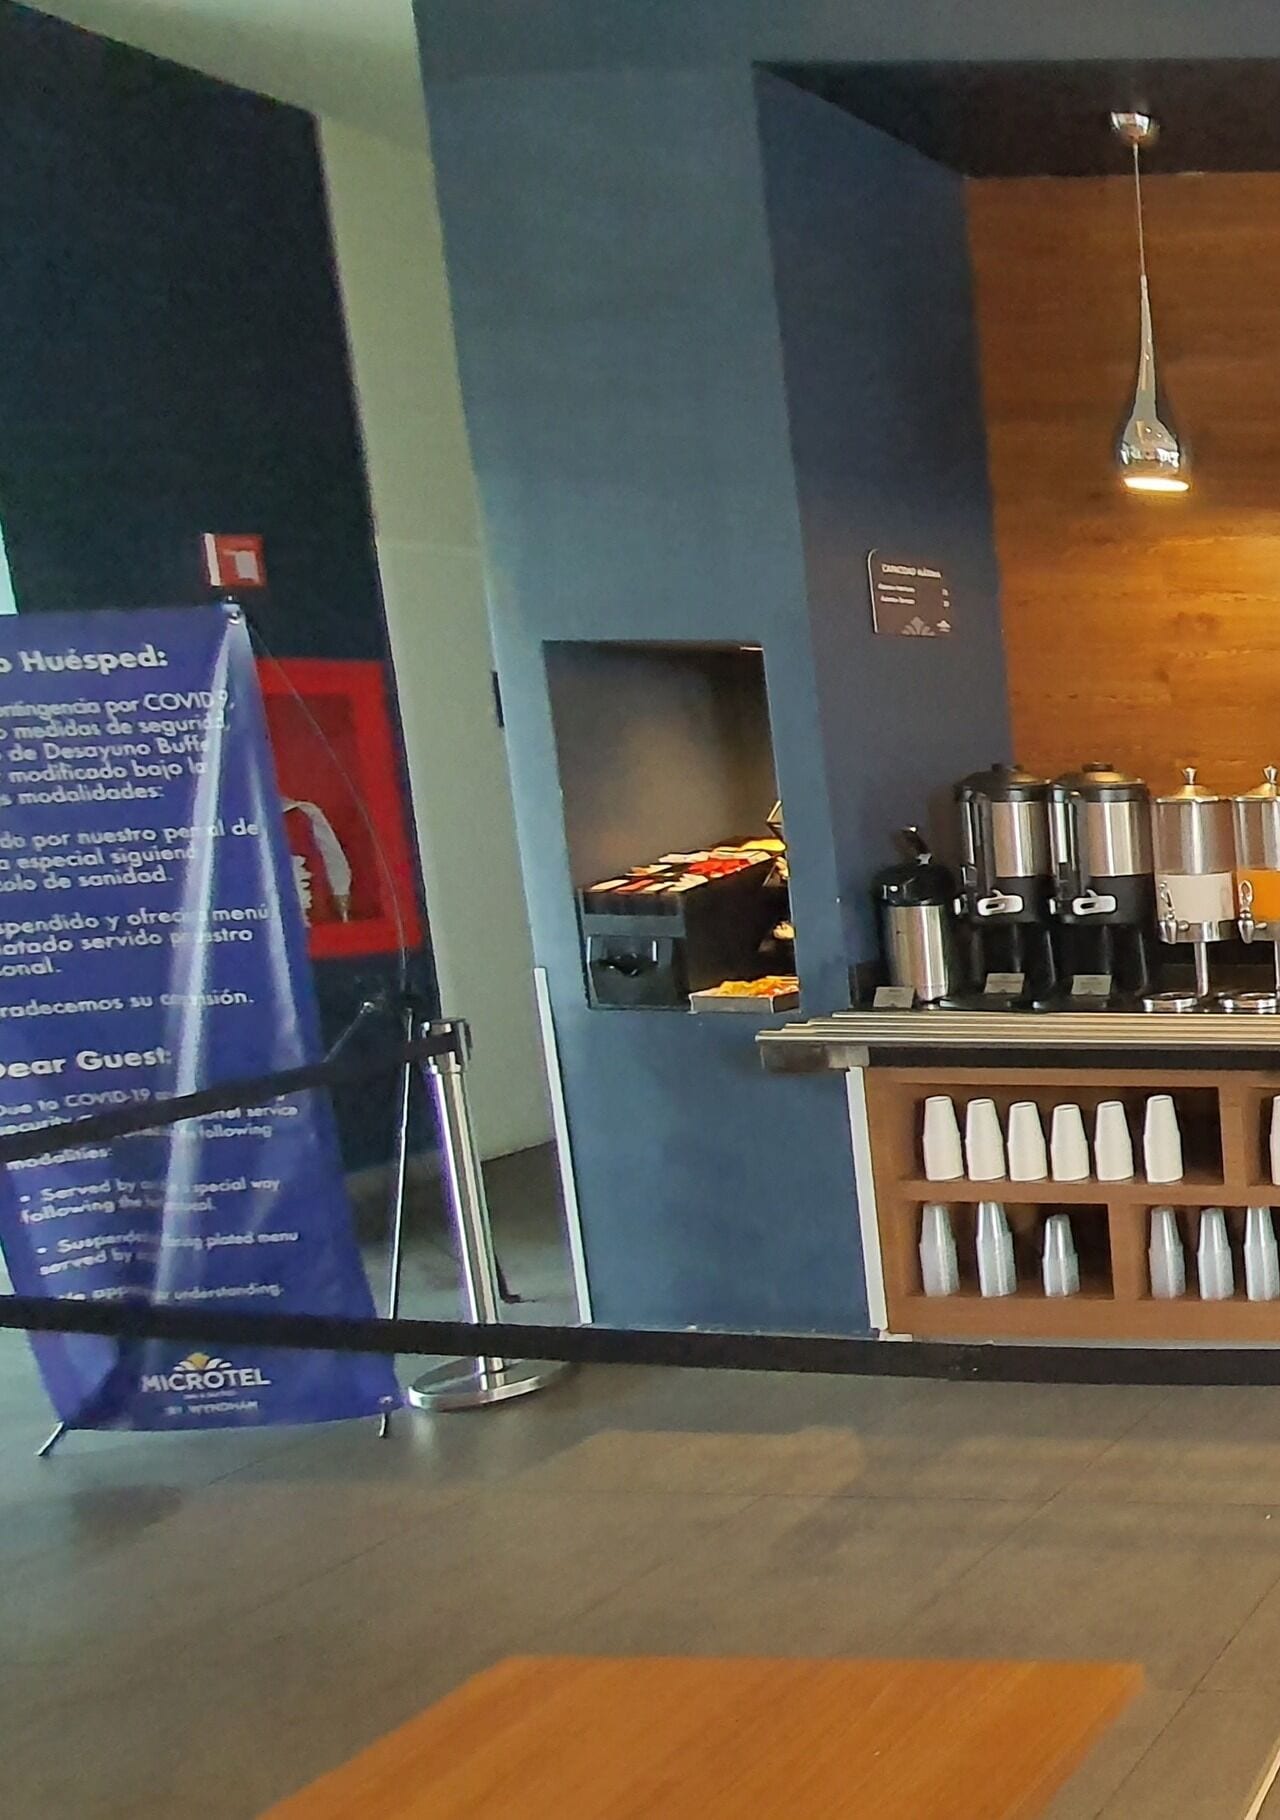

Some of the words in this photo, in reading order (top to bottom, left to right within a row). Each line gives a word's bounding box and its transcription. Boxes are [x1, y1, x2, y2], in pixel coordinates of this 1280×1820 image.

[18, 644, 168, 675] Huésped:
[105, 699, 139, 722] por
[13, 718, 101, 740] medidas
[106, 716, 130, 736] de
[8, 743, 37, 762] de
[43, 741, 151, 765] Desayuno
[8, 761, 127, 783] modificado
[132, 759, 183, 781] bajo
[18, 782, 164, 805] modalidades:
[32, 833, 70, 852] por
[77, 827, 157, 845] nuestro
[232, 817, 259, 836] de
[17, 847, 105, 874] especial
[43, 872, 71, 890] de
[78, 863, 175, 888] sanidad.
[104, 914, 120, 932] y
[212, 903, 268, 921] menú
[81, 928, 163, 951] servido
[130, 996, 153, 1009] su
[76, 1046, 173, 1072] Guest:
[38, 1099, 60, 1112] to
[64, 1086, 151, 1108] COVID-19
[40, 1179, 111, 1202] Served
[250, 1178, 280, 1192] way
[21, 1200, 115, 1224] following
[141, 1368, 271, 1393] MICROTEL
